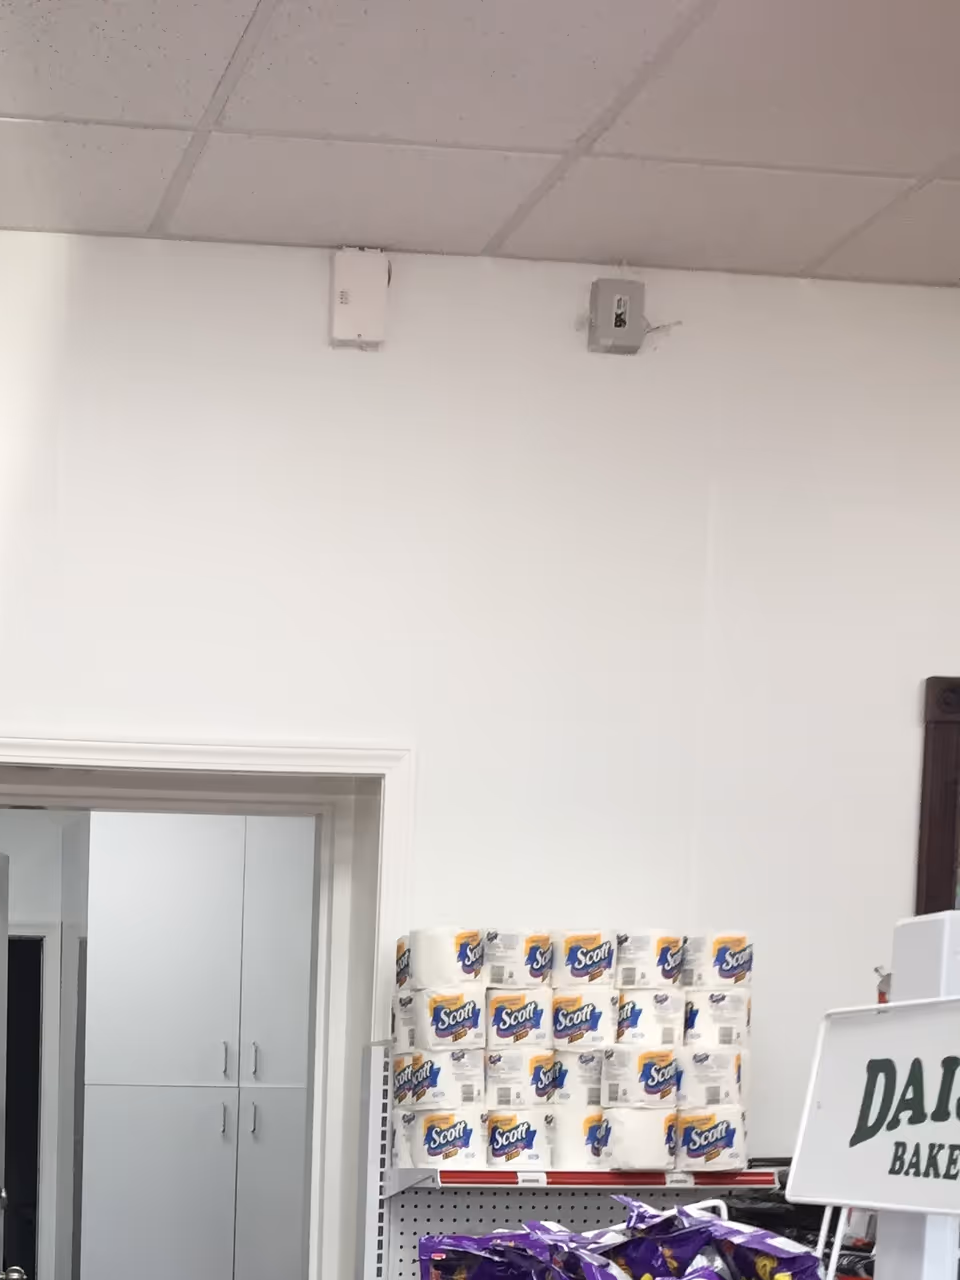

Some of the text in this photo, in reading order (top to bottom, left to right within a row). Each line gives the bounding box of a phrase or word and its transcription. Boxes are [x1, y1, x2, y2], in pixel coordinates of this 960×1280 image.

[574, 943, 610, 969] Scott
[438, 1002, 475, 1029] Scott
[499, 1002, 537, 1030] Scott
[556, 1004, 594, 1031] Scott
[430, 1121, 466, 1149] Scott
[493, 1122, 530, 1149] Scott
[689, 1120, 729, 1150] Scott
